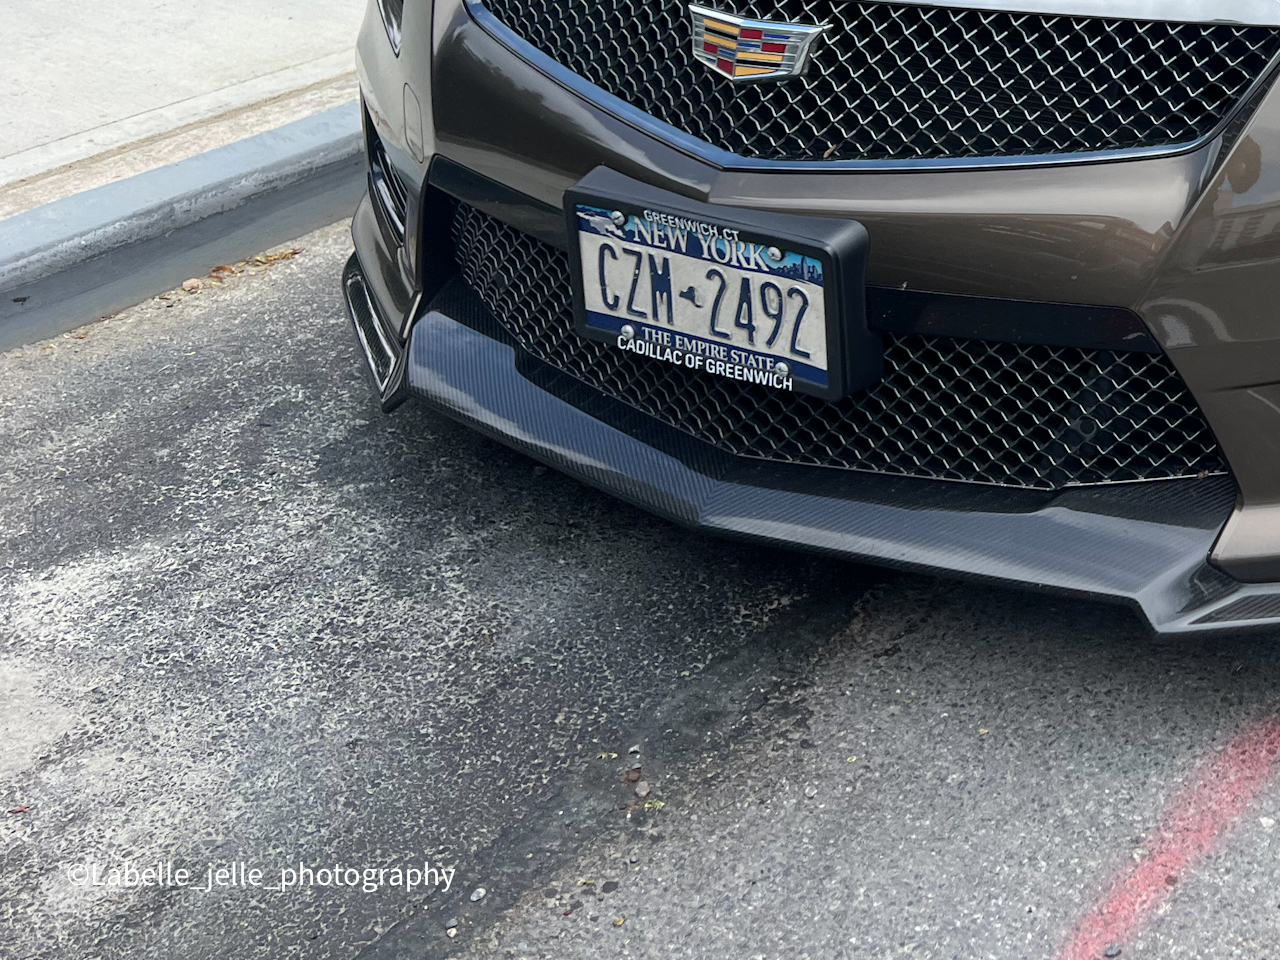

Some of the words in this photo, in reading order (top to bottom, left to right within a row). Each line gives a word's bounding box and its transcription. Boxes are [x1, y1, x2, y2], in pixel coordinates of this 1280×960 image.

[633, 216, 688, 254] NEW
[700, 236, 770, 272] YORK
[598, 242, 674, 326] CZM
[705, 267, 811, 359] 2492
[617, 335, 683, 366] CADILLAC
[685, 353, 703, 370] OF
[705, 359, 793, 391] GREENWICH
[641, 326, 672, 347] THE
[675, 335, 728, 361] EMPIRE
[730, 350, 776, 372] STATE
